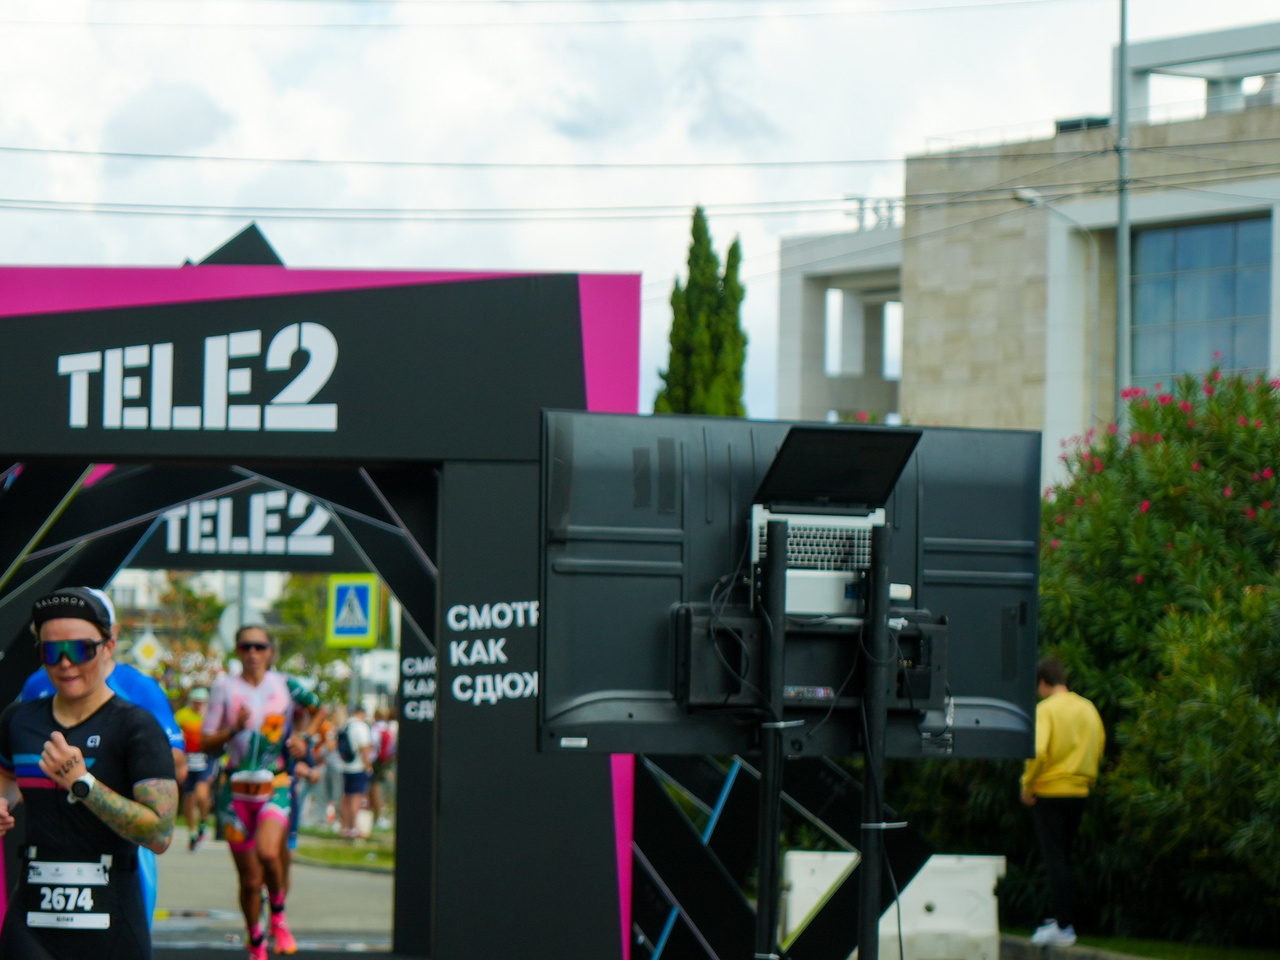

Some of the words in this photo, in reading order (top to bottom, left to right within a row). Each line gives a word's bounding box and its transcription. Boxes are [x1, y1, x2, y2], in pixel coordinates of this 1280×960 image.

[57, 321, 338, 432] TELE2
[162, 489, 335, 556] TELE2
[35, 596, 86, 608] SALOMON
[450, 637, 508, 666] КАК
[40, 886, 94, 912] 2674
